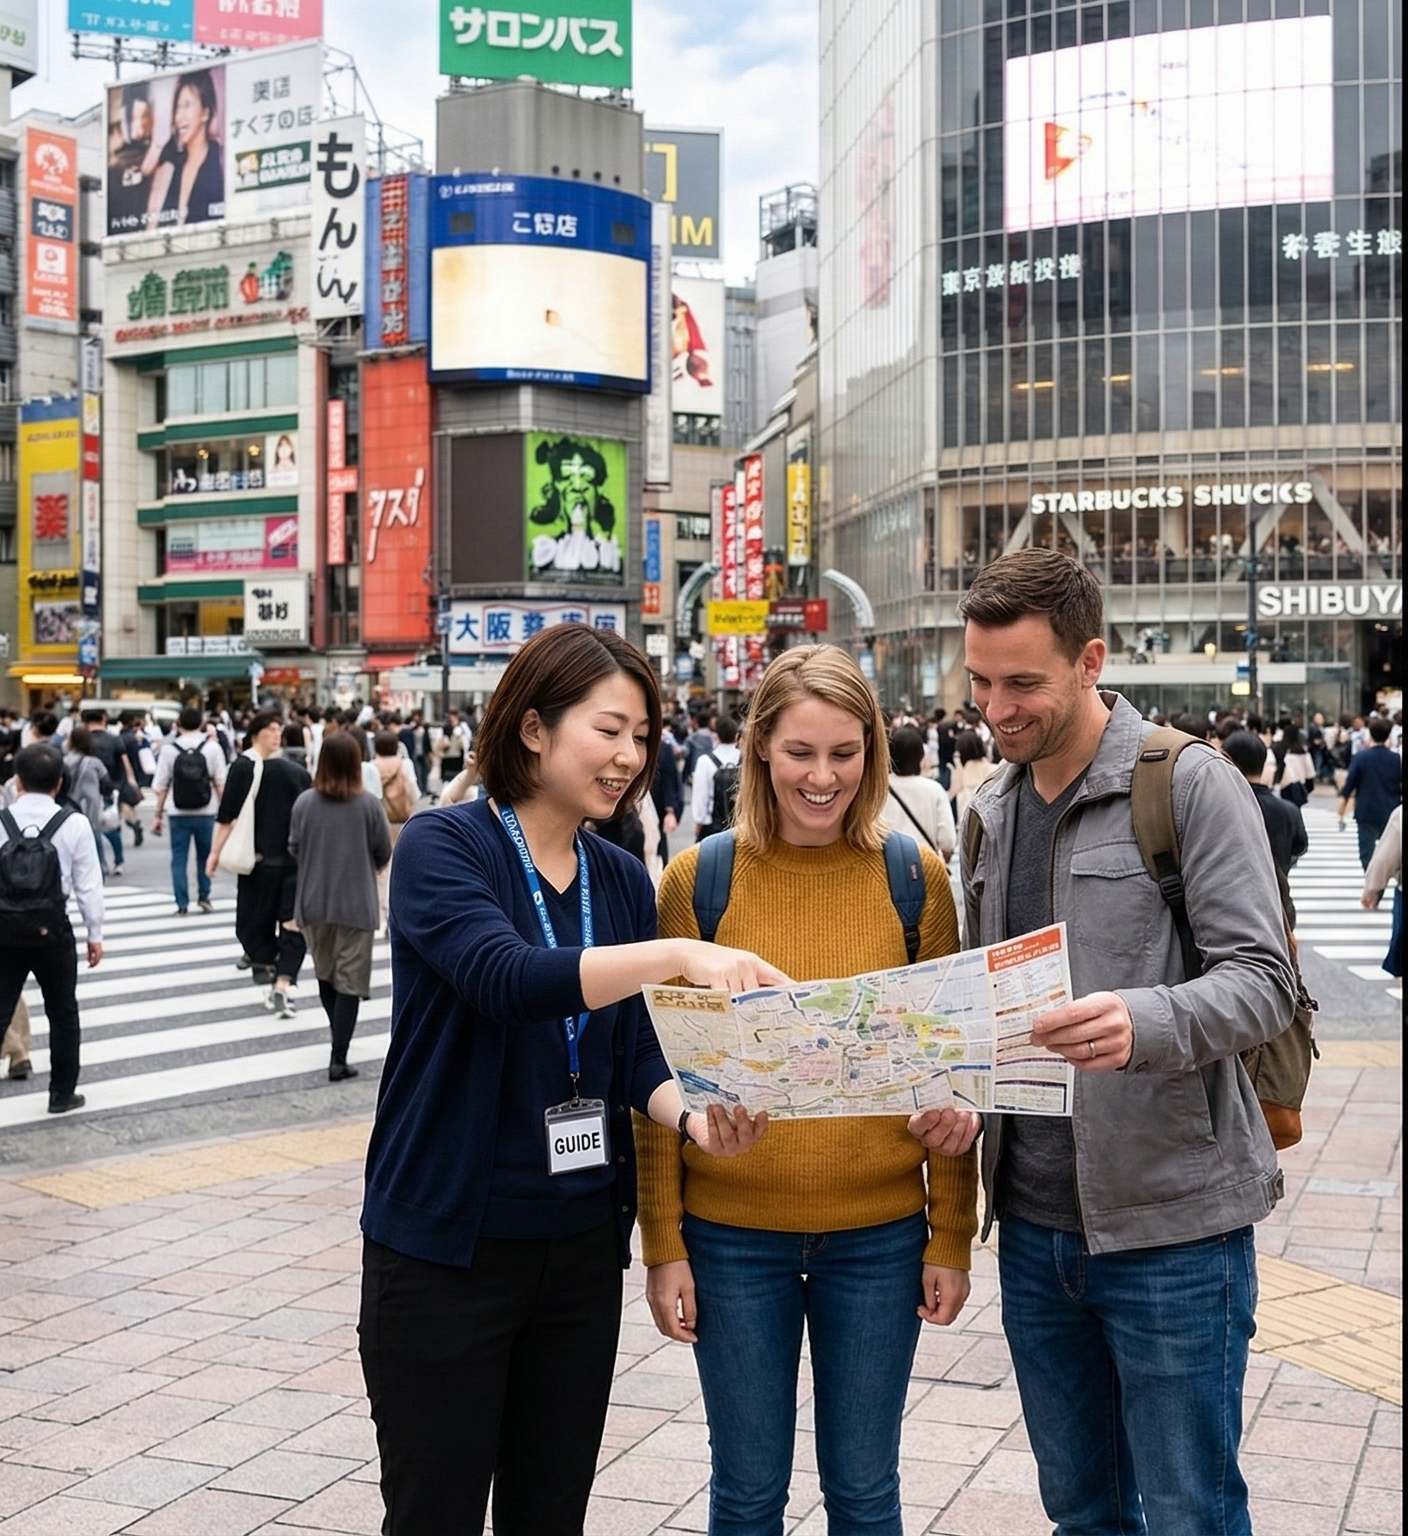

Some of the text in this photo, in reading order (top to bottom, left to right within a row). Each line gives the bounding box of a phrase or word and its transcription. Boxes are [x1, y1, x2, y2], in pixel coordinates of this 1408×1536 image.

[1031, 481, 1313, 515] STARBUCKS SHUCKS
[554, 1131, 601, 1155] GUIDE
